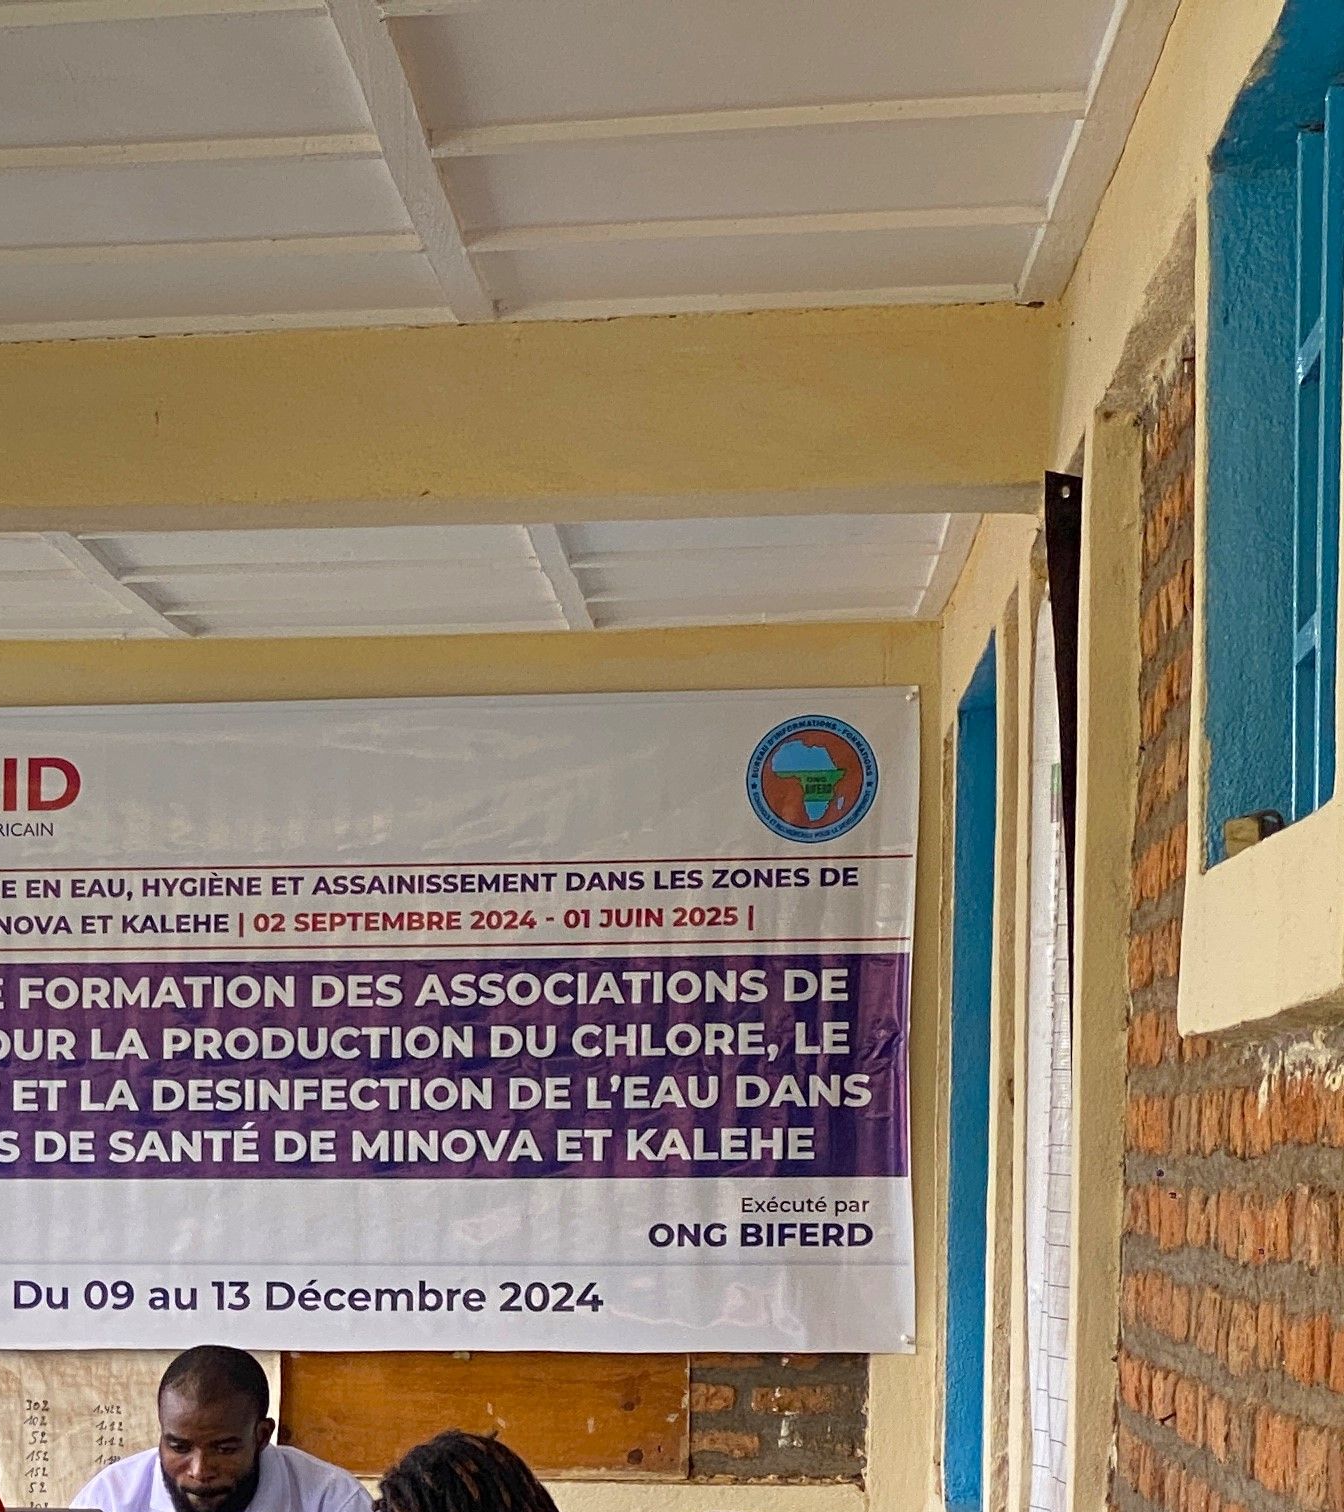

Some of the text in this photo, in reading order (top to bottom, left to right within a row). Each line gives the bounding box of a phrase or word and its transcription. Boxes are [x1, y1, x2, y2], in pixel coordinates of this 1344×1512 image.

[26, 879, 61, 899] EN
[70, 878, 134, 902] EAU,
[142, 871, 262, 898] HYGIÈNE
[271, 876, 305, 896] ET
[311, 872, 558, 896] ASSAINISSEMENT
[565, 870, 645, 892] DANS
[653, 869, 704, 890] LES
[711, 867, 810, 889] ZONES
[819, 866, 859, 888] DE
[81, 914, 114, 935] ET
[122, 913, 230, 934] KALEHE
[253, 913, 286, 933] 02
[293, 911, 462, 933] SEPTEMBRE
[469, 909, 537, 930] 2024
[563, 909, 591, 929] 01
[598, 907, 664, 928] JUIN
[672, 906, 739, 927] 2025
[19, 975, 295, 1010] FORMATION
[311, 974, 403, 1008] DES
[414, 969, 768, 1007] ASSOCIATIONS
[783, 968, 849, 1002] DE
[90, 1028, 150, 1060] LA
[162, 1025, 473, 1060] PRODUCTION
[490, 1025, 557, 1058] DU
[571, 1022, 779, 1062] CHLORE,
[794, 1021, 850, 1055] LE
[12, 1079, 67, 1112] ET
[80, 1079, 140, 1113] LA
[152, 1077, 492, 1111] DESINFECTION
[508, 1077, 571, 1110] DE
[586, 1074, 719, 1110] L'EAU
[735, 1073, 872, 1108] DANS
[34, 1130, 96, 1163] DE
[108, 1121, 260, 1163] SANTÉ
[274, 1130, 337, 1162] DE
[352, 1129, 543, 1163] MINOVA
[556, 1129, 613, 1162] ET
[626, 1127, 815, 1161] KALEHE
[741, 1195, 870, 1218] Exécuté par
[648, 1222, 874, 1248] ONG BIFERD
[13, 1279, 604, 1313] Du 09 au 13 Décembre 2024
